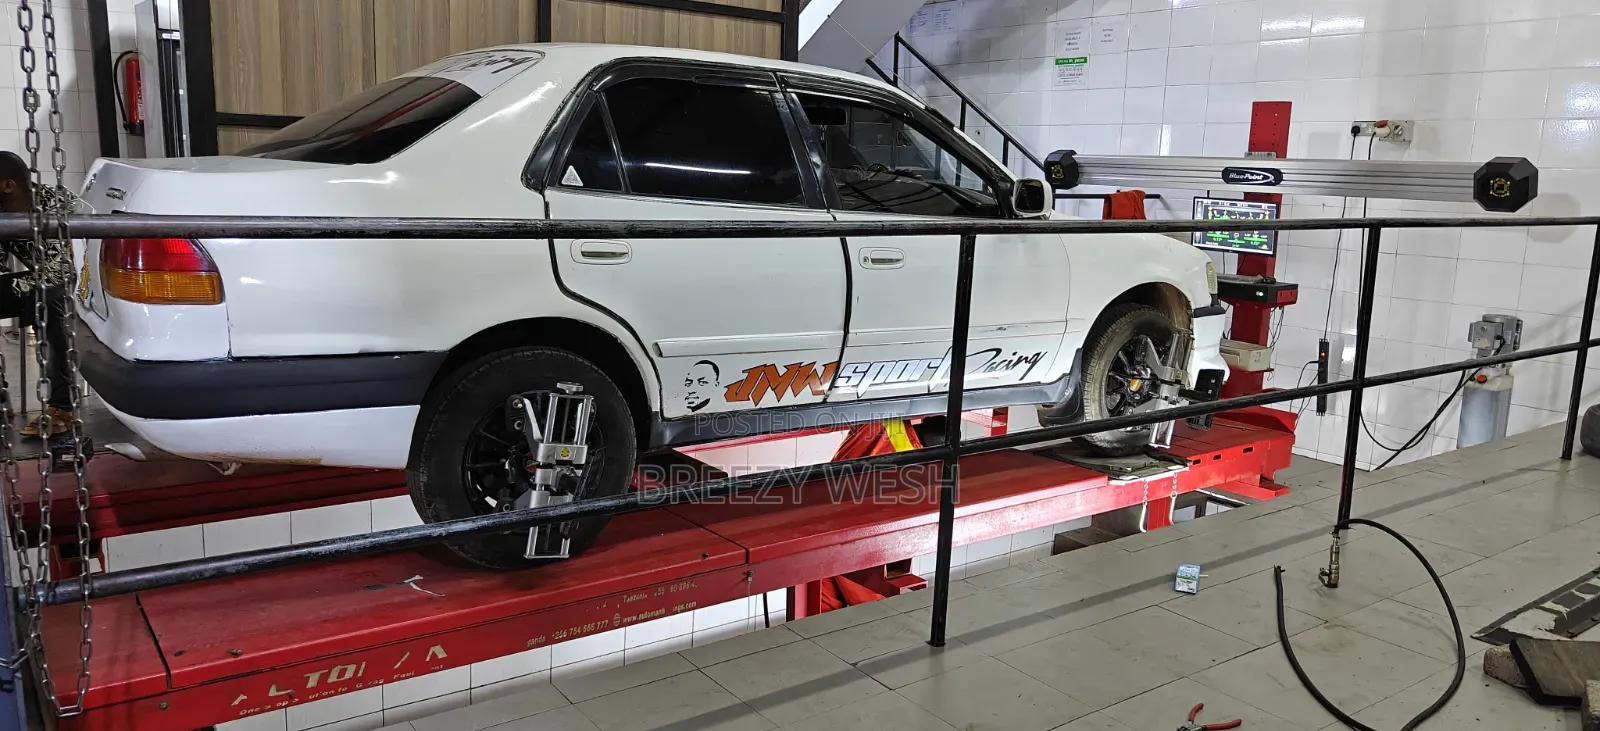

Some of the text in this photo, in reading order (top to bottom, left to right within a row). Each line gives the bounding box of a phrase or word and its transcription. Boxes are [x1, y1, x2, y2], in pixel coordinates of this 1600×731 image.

[724, 361, 839, 407] JMW
[569, 625, 582, 638] 754
[596, 619, 609, 631] 777
[622, 600, 697, 624] www.automanhings.com
